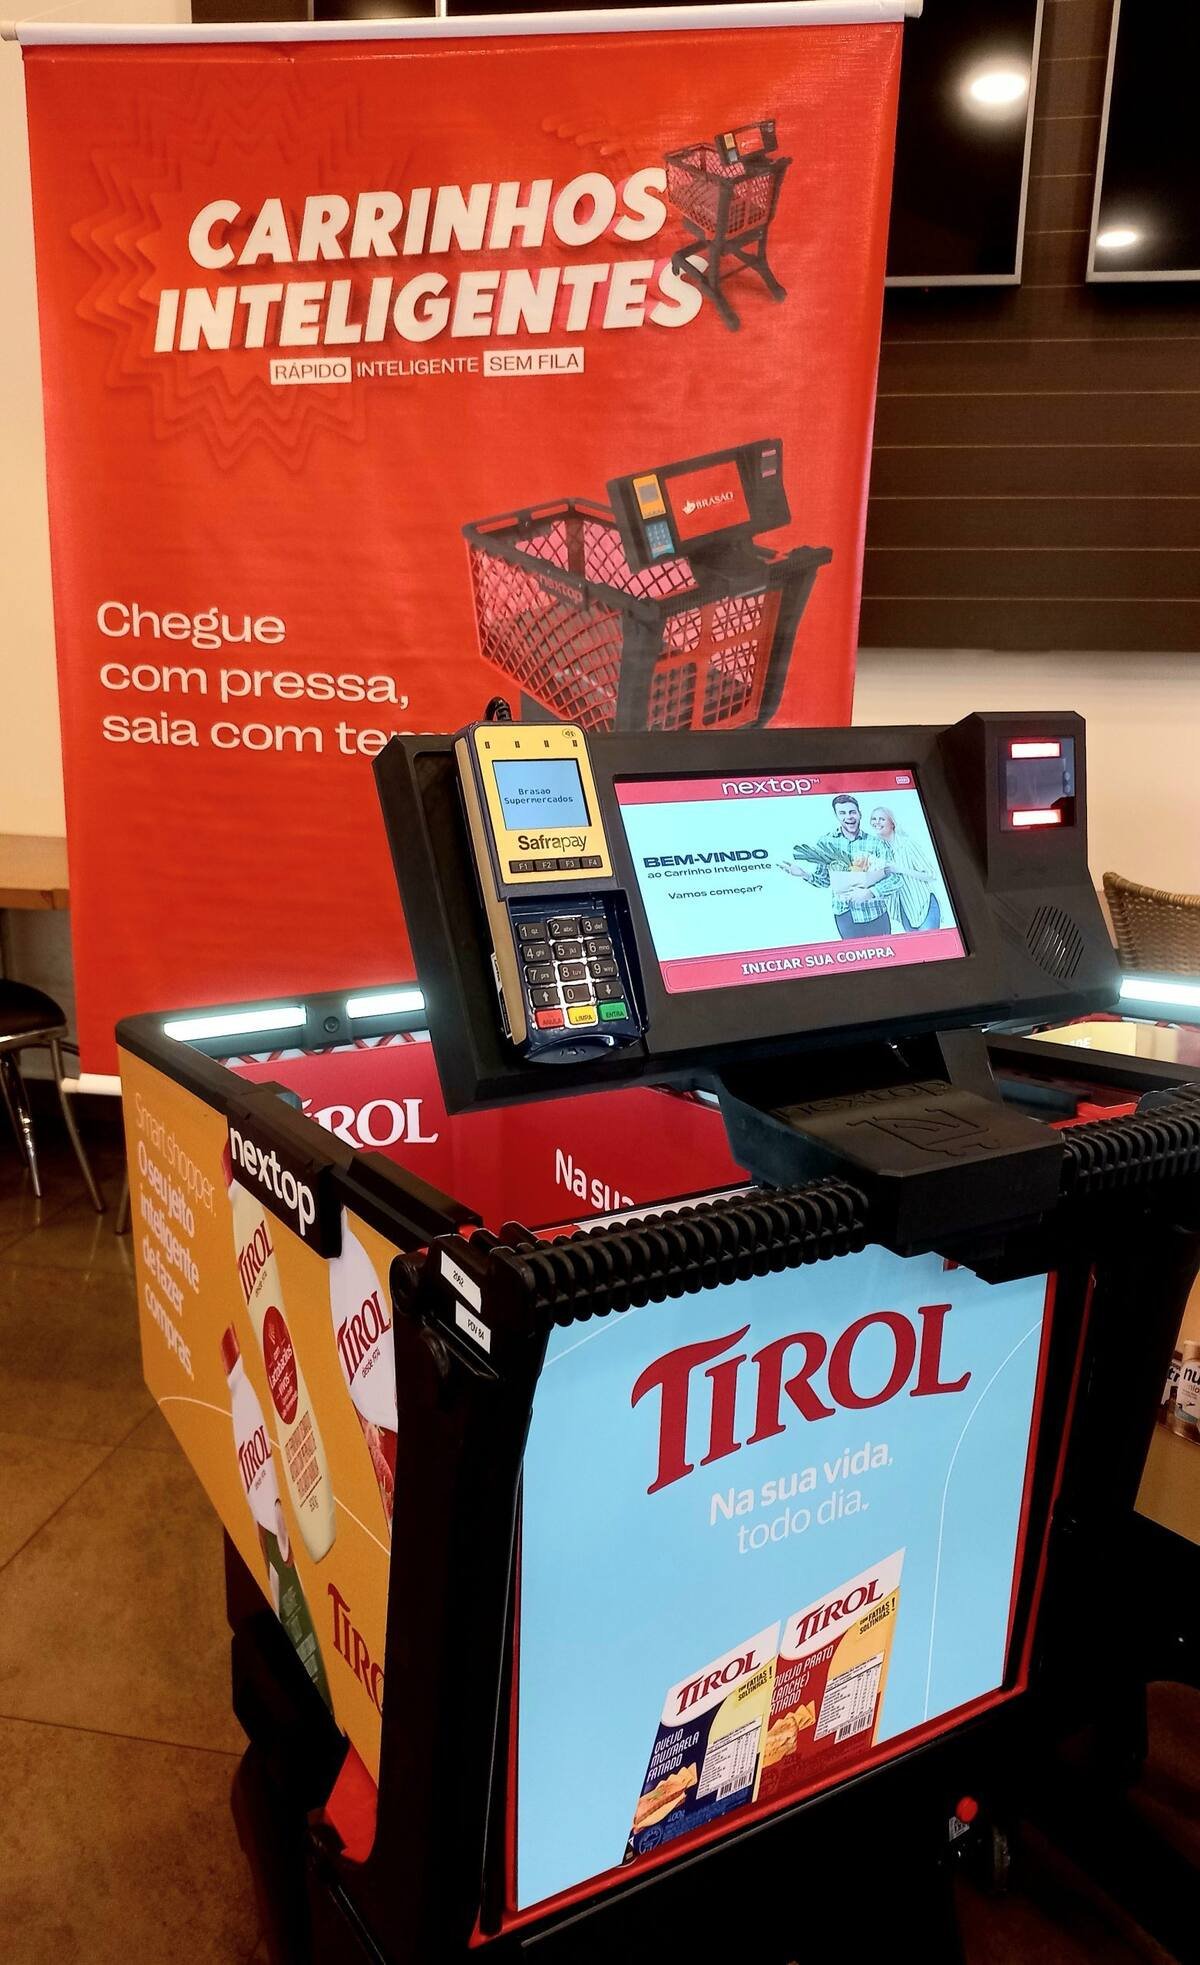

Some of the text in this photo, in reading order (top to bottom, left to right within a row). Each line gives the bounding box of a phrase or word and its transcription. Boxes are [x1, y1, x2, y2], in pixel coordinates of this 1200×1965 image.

[188, 167, 668, 270] CARRINHOS
[154, 254, 710, 353] INTELIGENTES
[274, 353, 580, 380] RÁPIDO INTELIGENTE SEM FILA
[97, 600, 287, 650] Chegue
[100, 662, 410, 710] com pressa,
[102, 710, 199, 748] saia
[210, 721, 324, 754] com
[504, 795, 574, 805] Supermercados
[518, 788, 551, 796] Brasao
[517, 834, 587, 853] Safrapay
[643, 849, 769, 868] BEM-VINDO
[518, 858, 598, 871] F1 F2 F3 F4
[664, 867, 713, 878] Carrinho
[714, 863, 772, 874] Inteligente
[668, 884, 763, 900] Vamos começar?
[521, 925, 528, 937] 1
[552, 923, 560, 935] 2
[584, 920, 593, 932] 3
[526, 947, 534, 959] 4
[557, 945, 565, 956] 5
[589, 942, 597, 953] 6
[741, 946, 896, 976] INICIAR SUA COMPRA
[530, 969, 537, 983] 7
[562, 966, 570, 978] 8
[594, 963, 601, 975] 9
[566, 988, 575, 1000] 0
[575, 1014, 593, 1022] LIMPA
[136, 1092, 168, 1158] Smart
[229, 1127, 316, 1237] nextop
[555, 1148, 587, 1201] Na
[140, 1182, 200, 1295] inteligente
[237, 1219, 274, 1306] TIROL
[337, 1290, 392, 1387] TIROL
[631, 1303, 972, 1496] TIROL
[238, 1424, 273, 1495] TIROL
[710, 1440, 894, 1526] Na sua vida,
[737, 1506, 811, 1555] todo
[795, 1578, 884, 1649] TIROL
[868, 1601, 890, 1622] FATIAS
[803, 1644, 834, 1673] PRATO
[676, 1649, 761, 1717] TIROL
[746, 1669, 767, 1690] FATIAS
[654, 1727, 684, 1755] QUEIJO
[646, 1753, 683, 1784] FATIADO
